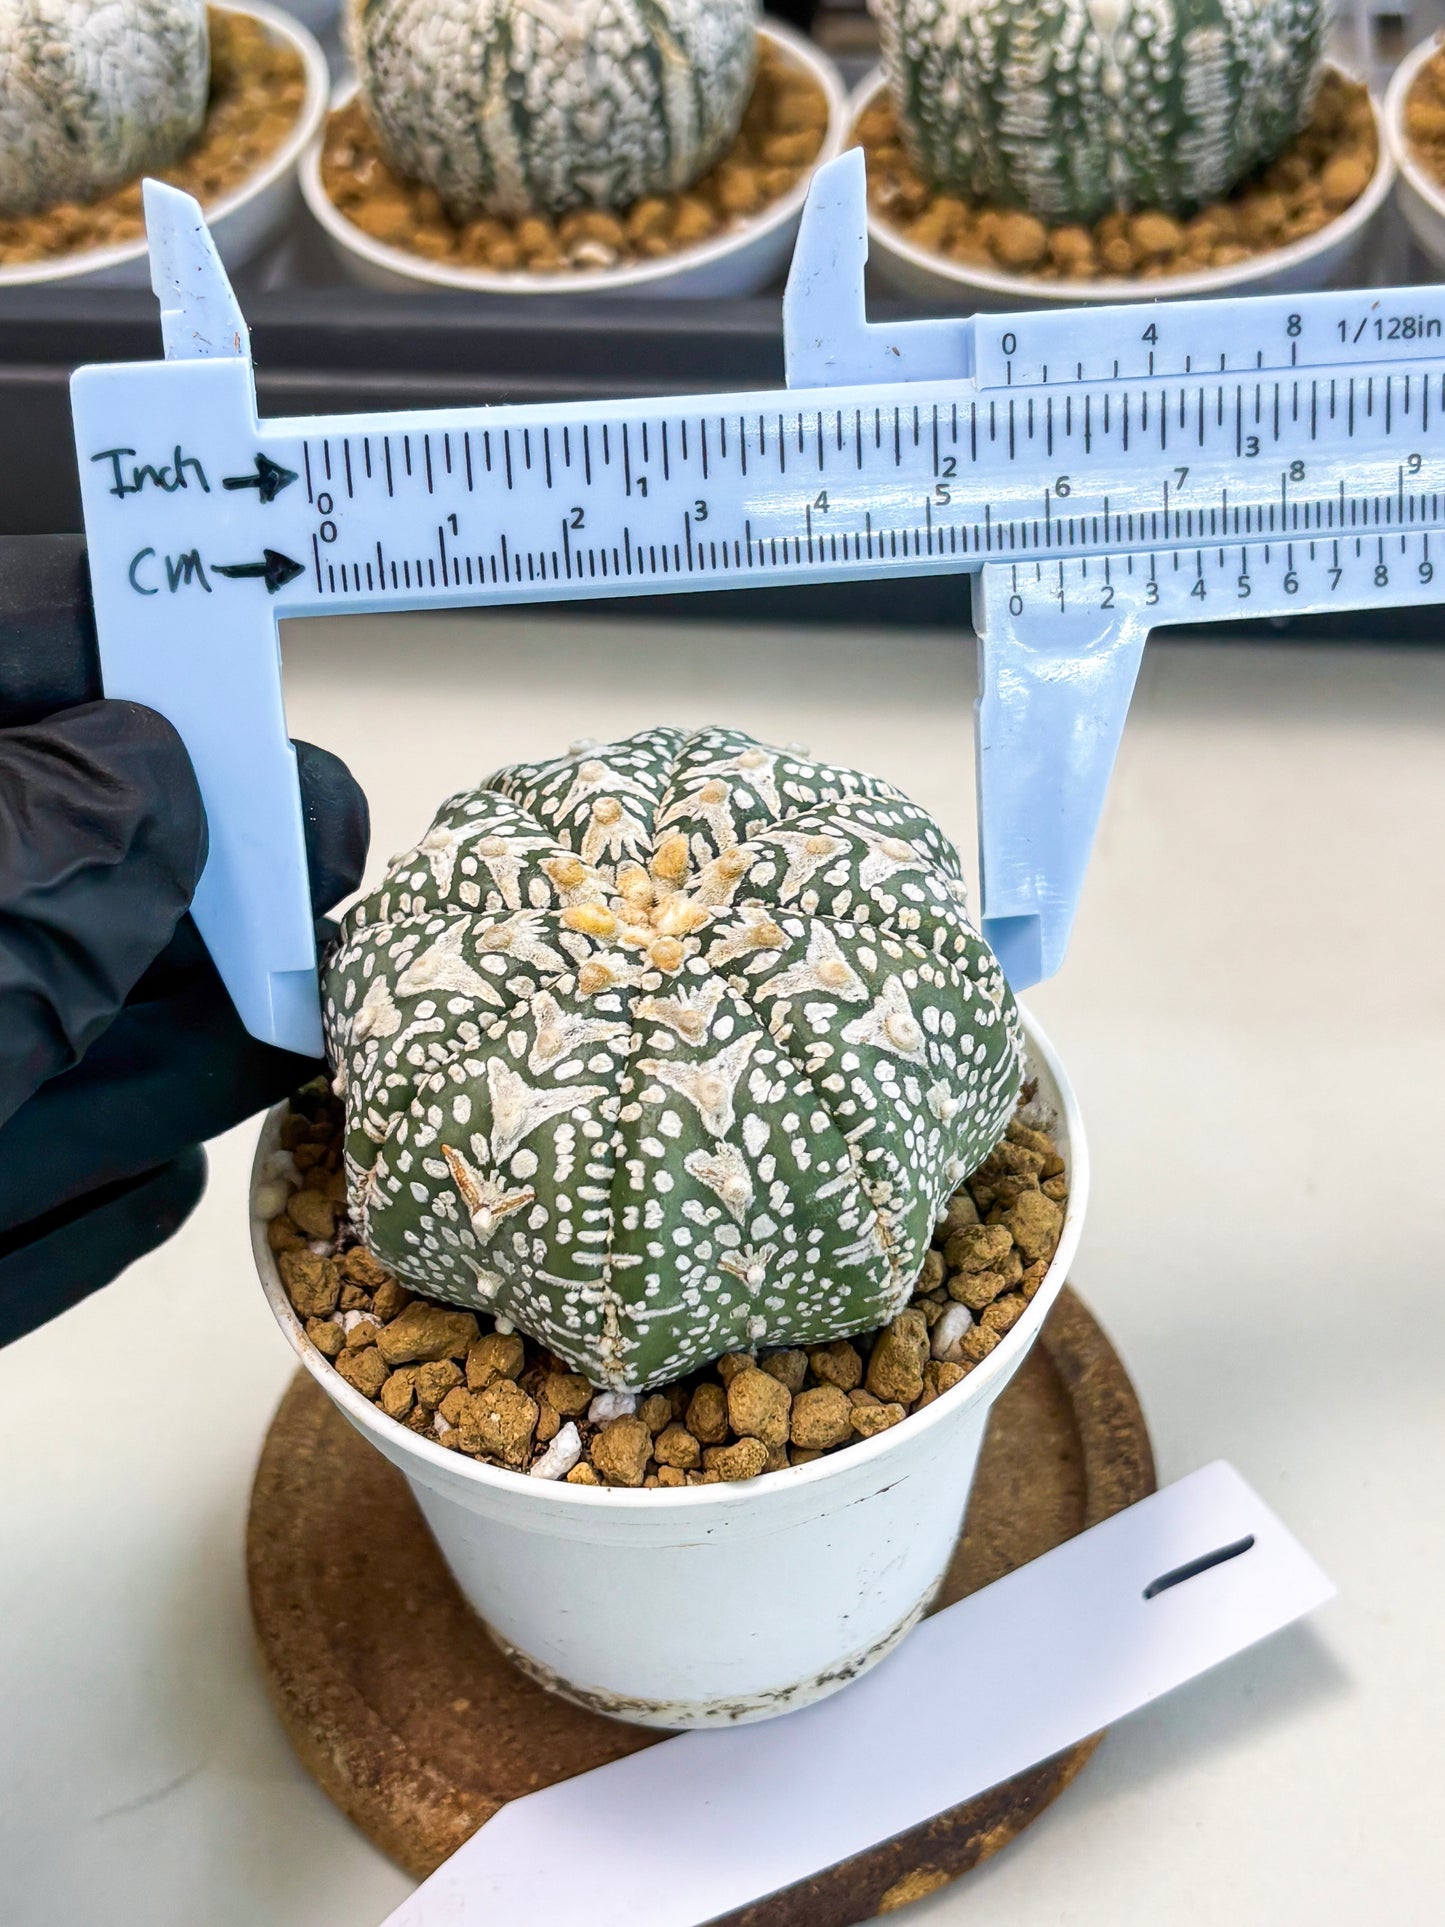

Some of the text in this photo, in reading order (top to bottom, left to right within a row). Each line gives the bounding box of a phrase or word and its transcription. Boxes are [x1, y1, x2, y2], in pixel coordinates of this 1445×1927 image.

[1002, 314, 1442, 355] 0 4 8 1/128in
[91, 445, 211, 499] Inch
[317, 436, 1260, 515] 0 1 2 3
[320, 453, 1422, 543] 0 1 2 3 4 5 6 7 8 9
[1009, 561, 1433, 616] 0 1 2 3 4 5 6 7 8 9
